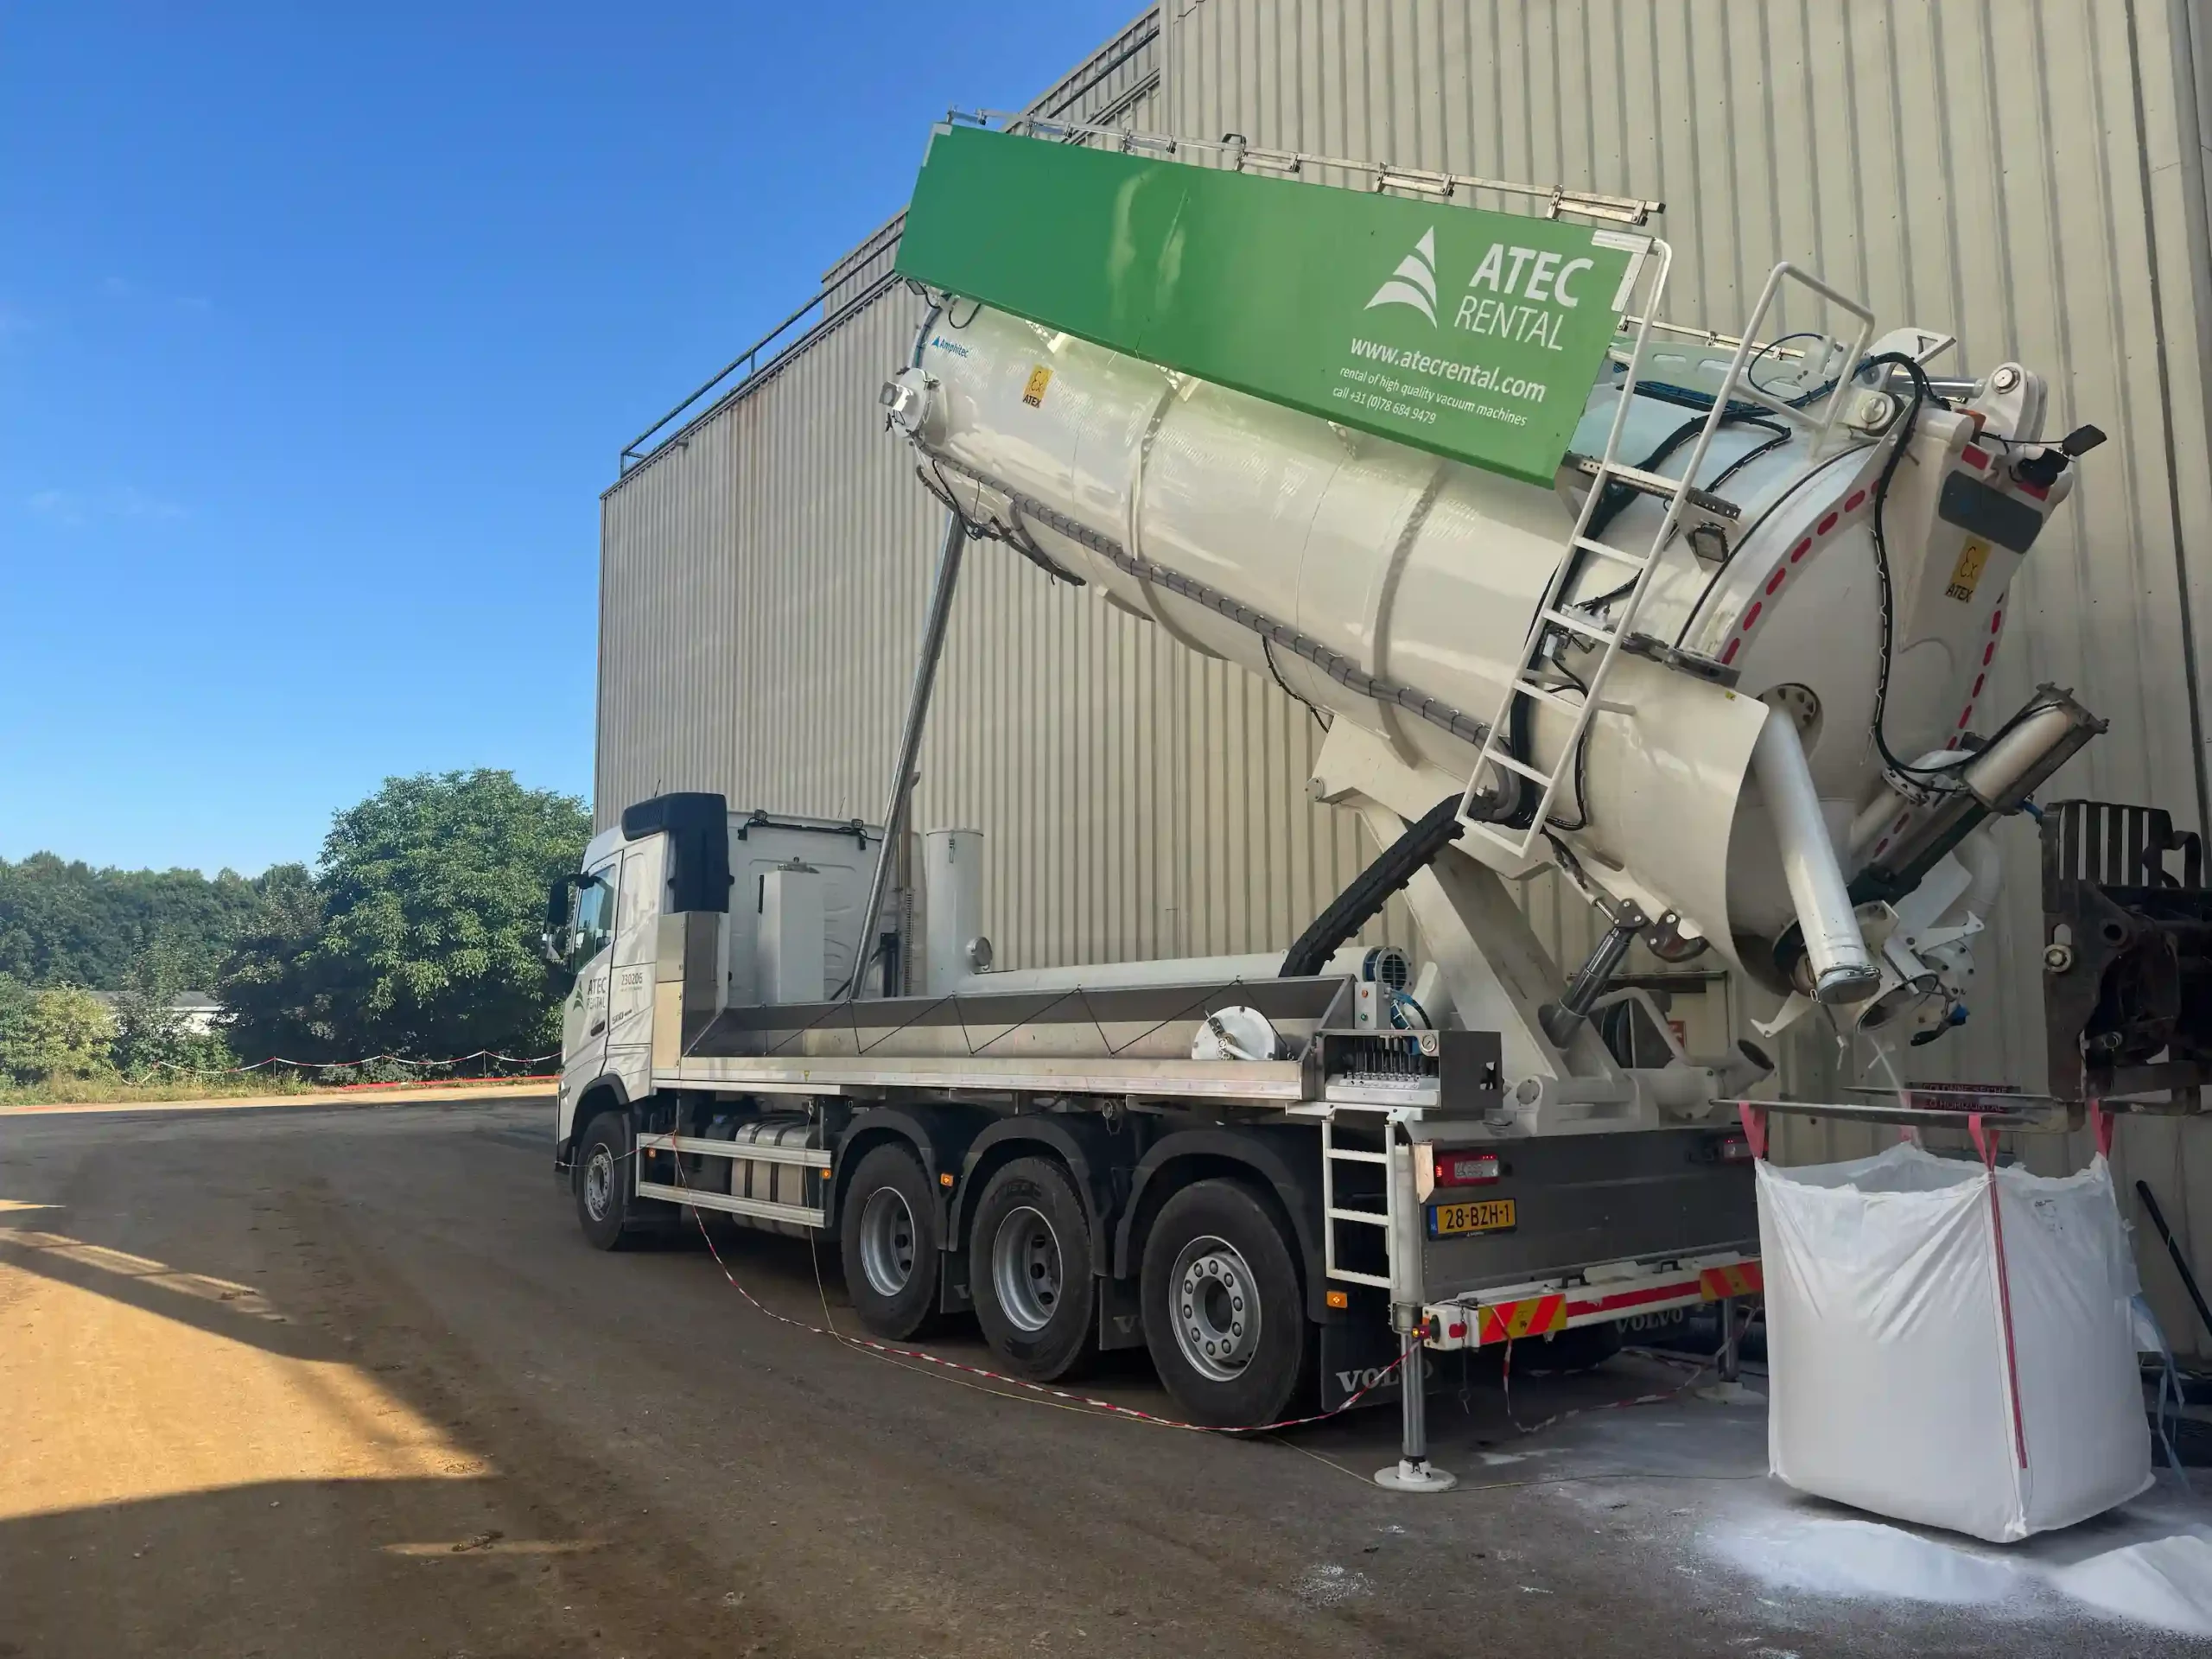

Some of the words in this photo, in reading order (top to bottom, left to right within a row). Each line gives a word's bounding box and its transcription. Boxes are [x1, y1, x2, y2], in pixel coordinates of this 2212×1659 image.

[1469, 243, 1595, 308] ATEC
[1453, 295, 1564, 351] RENTAL
[940, 339, 969, 358] Amphitec
[1350, 337, 1547, 403] www.atecrental.com
[1022, 394, 1042, 409] ATEX
[1332, 385, 1349, 400] call
[1350, 391, 1367, 405] +31
[1367, 394, 1393, 412] (0)78
[1392, 401, 1410, 416] 684
[1410, 407, 1437, 425] 9479
[1339, 366, 1368, 385] rental
[1368, 373, 1381, 385] of
[1379, 375, 1401, 392] high
[1401, 382, 1435, 404] quality
[1435, 392, 1475, 413] vacuum
[1476, 403, 1529, 427] machines
[1945, 582, 1974, 603] ATEX
[588, 976, 607, 995] ATEC
[1446, 1203, 1510, 1230] 28-BZH-1
[1615, 1308, 1684, 1335] VOLVO
